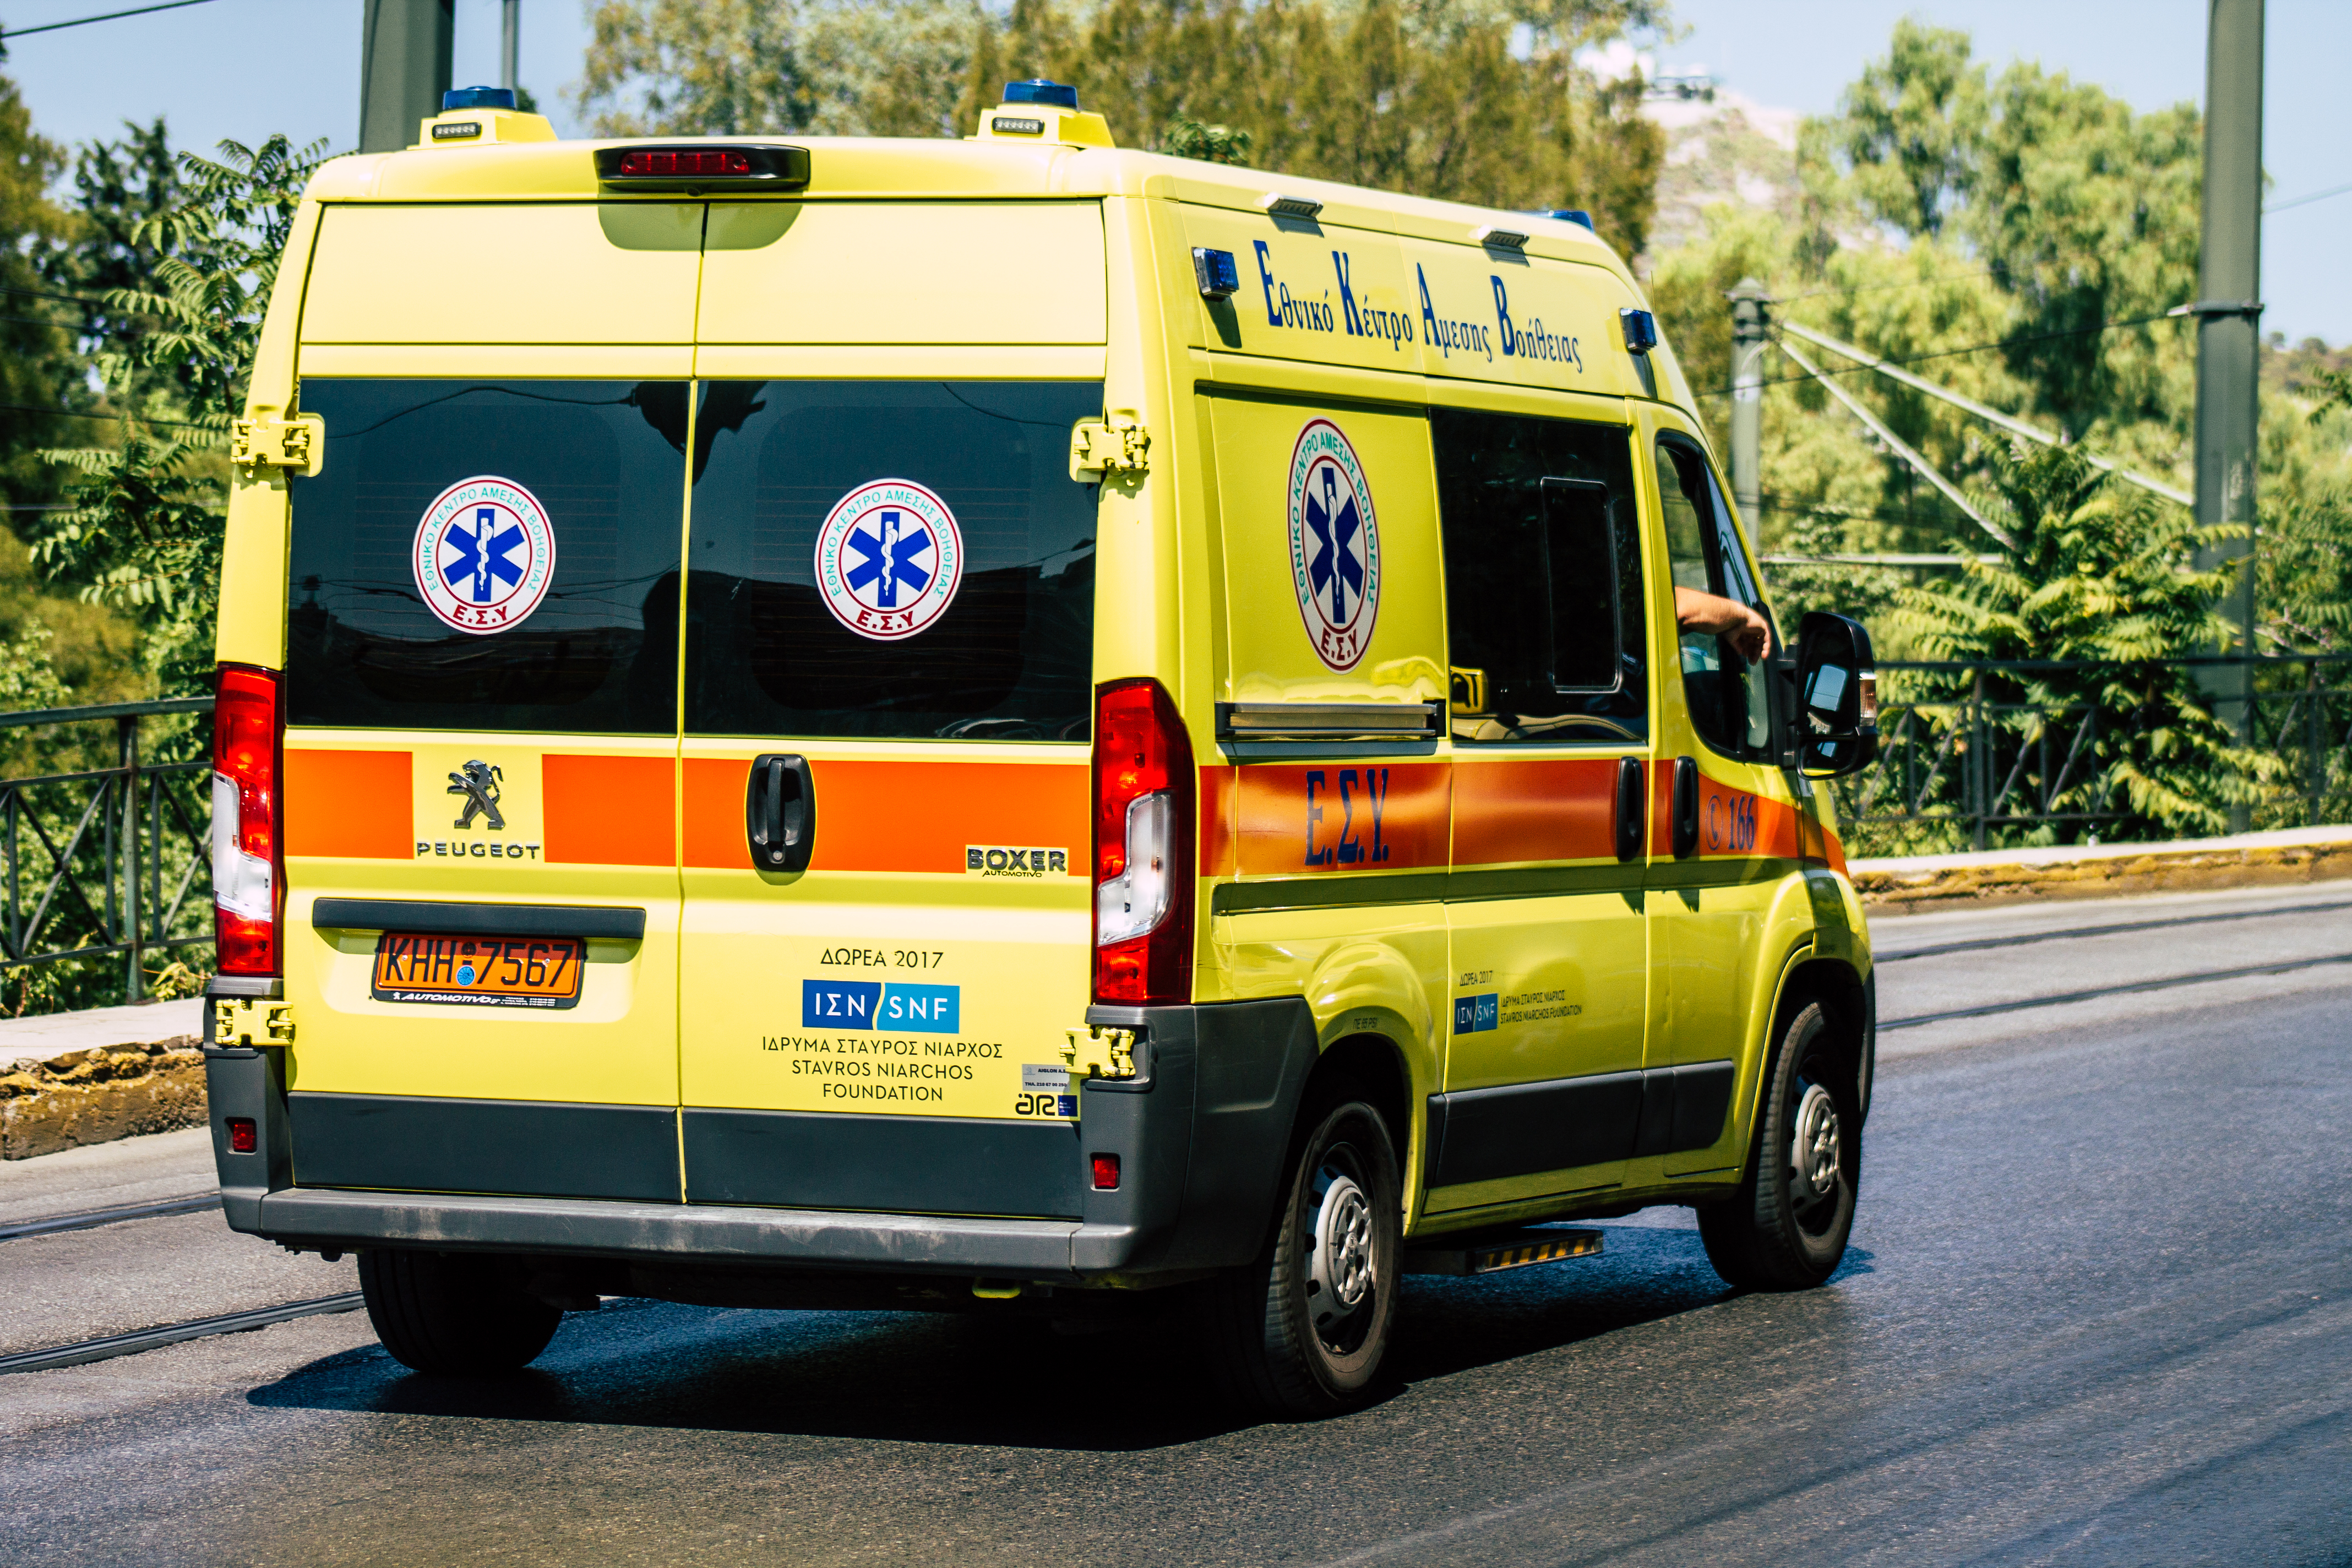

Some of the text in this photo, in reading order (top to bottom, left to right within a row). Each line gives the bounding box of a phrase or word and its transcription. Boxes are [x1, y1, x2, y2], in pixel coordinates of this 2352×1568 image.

[1253, 239, 1583, 374] Εθνικό Κέντρο Αμεσης Βοήθειας
[1292, 431, 1376, 608] ΕΘΝΙΚΟ ΚΕΝΤΡΟ ΑΜΕΣΗΣ ΒΟΗΘΕΙΑΣ
[423, 487, 545, 593] ΕΘΝΙΚΟ ΚΕΝΤΡΟ ΑΜΕΣΗΣ ΒΟΗΘΕΙΑΣ
[826, 490, 952, 598] ΕΘΝΙΚΟ ΚΕΝΤΡΟ ΑΜΕΣΗΣ ΒΟΗΘΕΙΑΣ
[453, 604, 507, 624] Ε.Σ.Υ
[856, 609, 913, 630] Ε.Σ.Υ
[1728, 795, 1755, 851] 166
[417, 842, 540, 859] PEUGEOT
[967, 847, 1066, 872] BOXER
[820, 948, 944, 968] ΔΩΡΕΑ 2017
[1460, 970, 1493, 987] ΔΩΡΕΑ 2017
[815, 993, 948, 1020] ΙΣΝ SNF
[1457, 1003, 1495, 1024] ΙΣΝ SNF
[1500, 1005, 1582, 1024] STAVROS NIARCHOS FOUNDATION
[763, 1036, 1003, 1058] ΙΔΡΥΜΑ ΣΤΑΥΡΟΣ ΝΙΑΡΧΟΣ
[792, 1060, 973, 1080] STAVROS NIARCHOS
[823, 1083, 943, 1101] FOUNDATION
